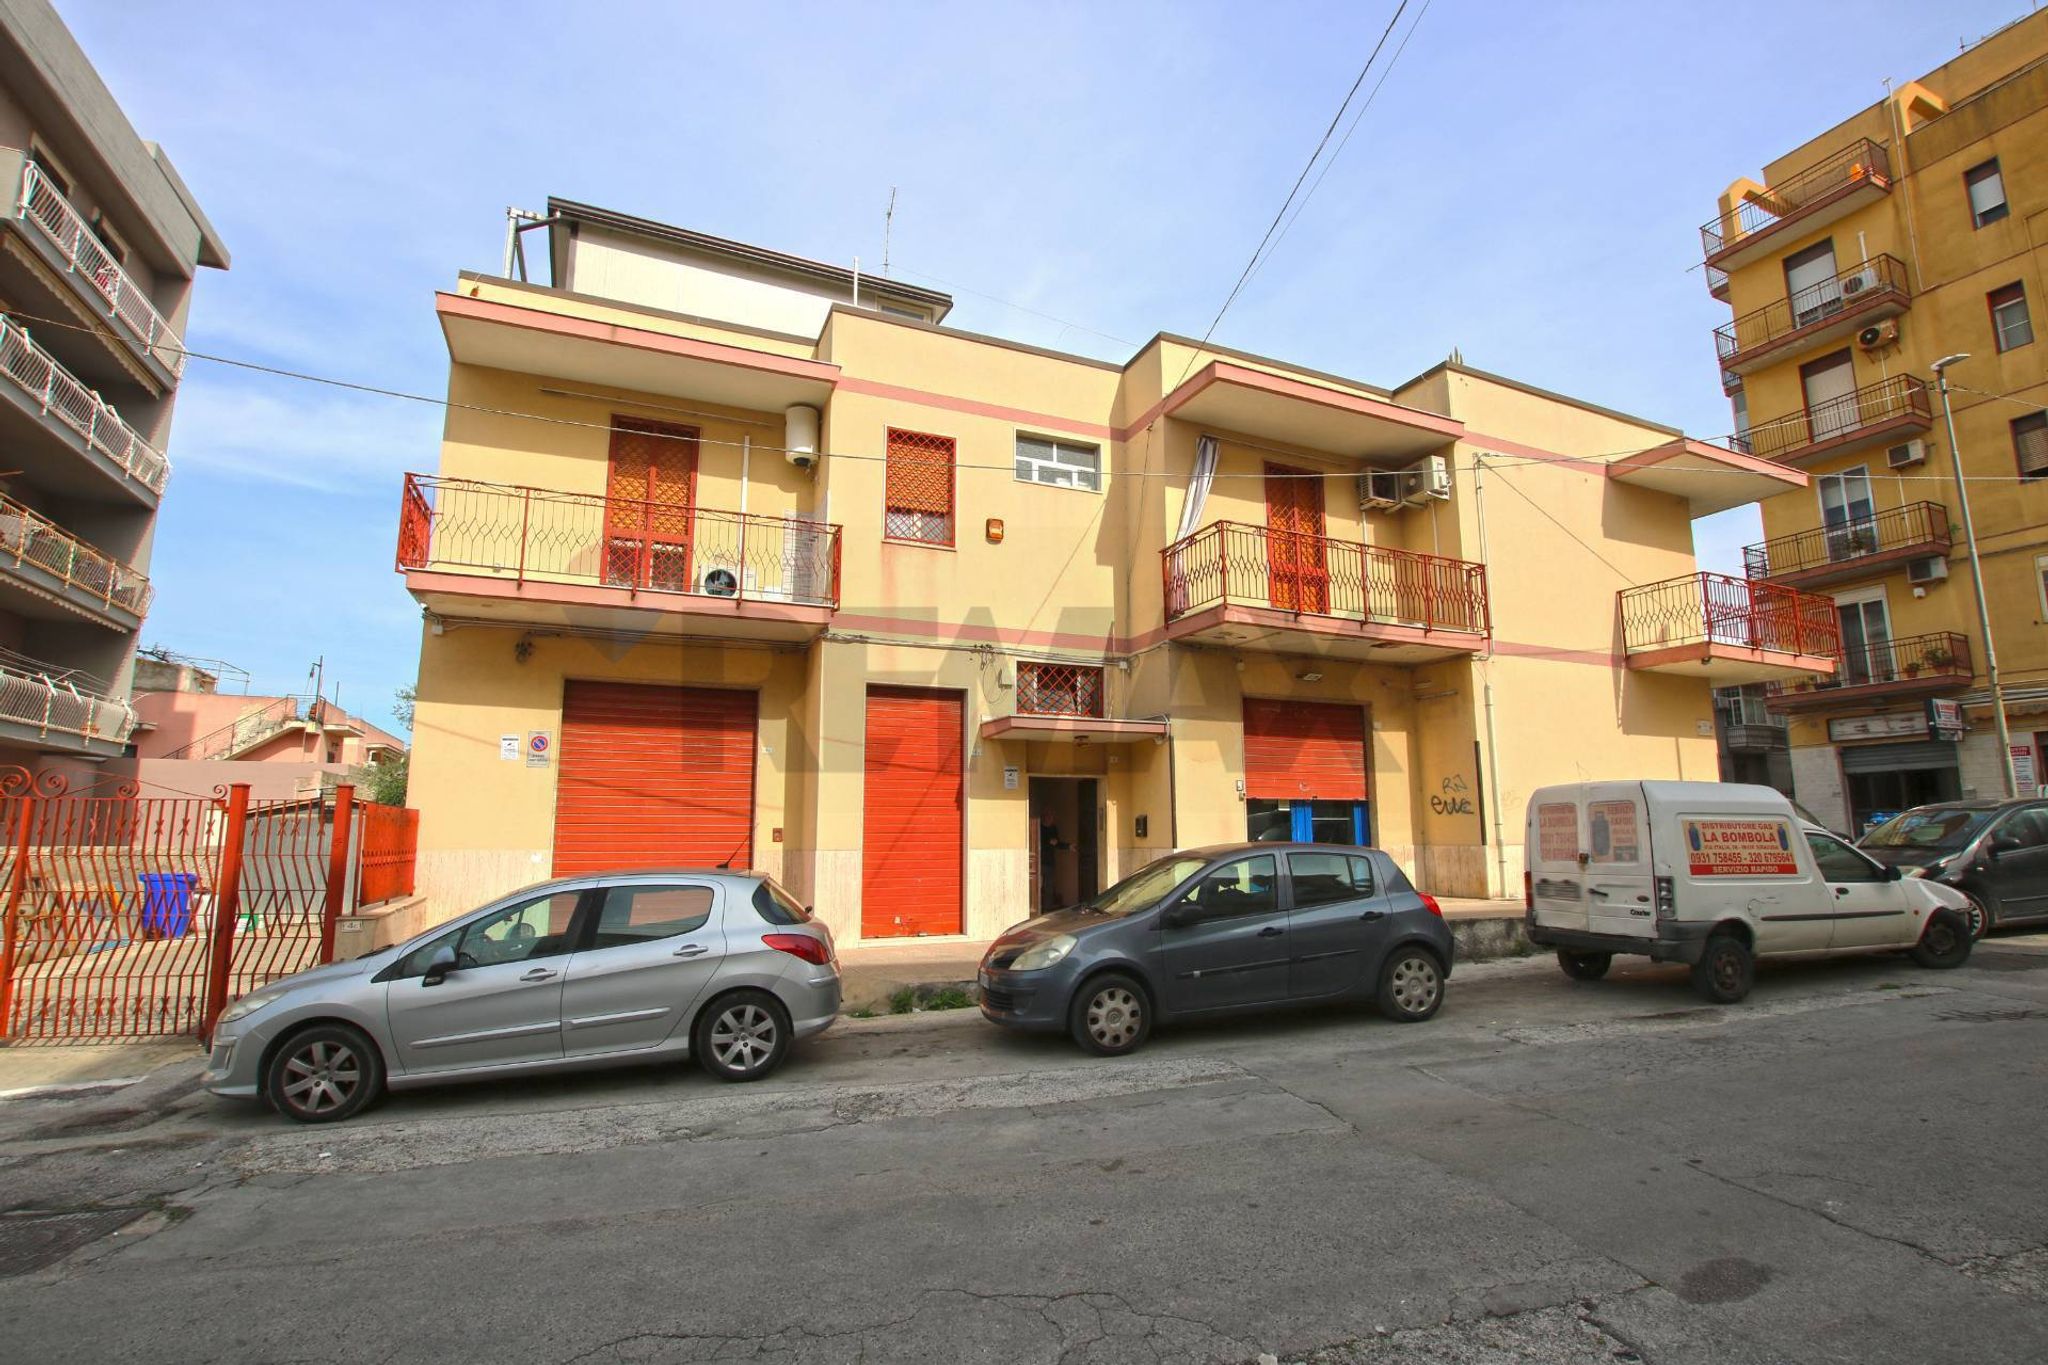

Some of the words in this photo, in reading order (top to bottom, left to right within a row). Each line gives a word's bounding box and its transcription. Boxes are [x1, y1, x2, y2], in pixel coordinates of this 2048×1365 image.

[1702, 832, 1719, 842] LA
[1721, 832, 1777, 842] BOMBOLA
[1690, 853, 1710, 863] 0931
[1713, 853, 1741, 863] 758455
[1748, 853, 1763, 863] 320
